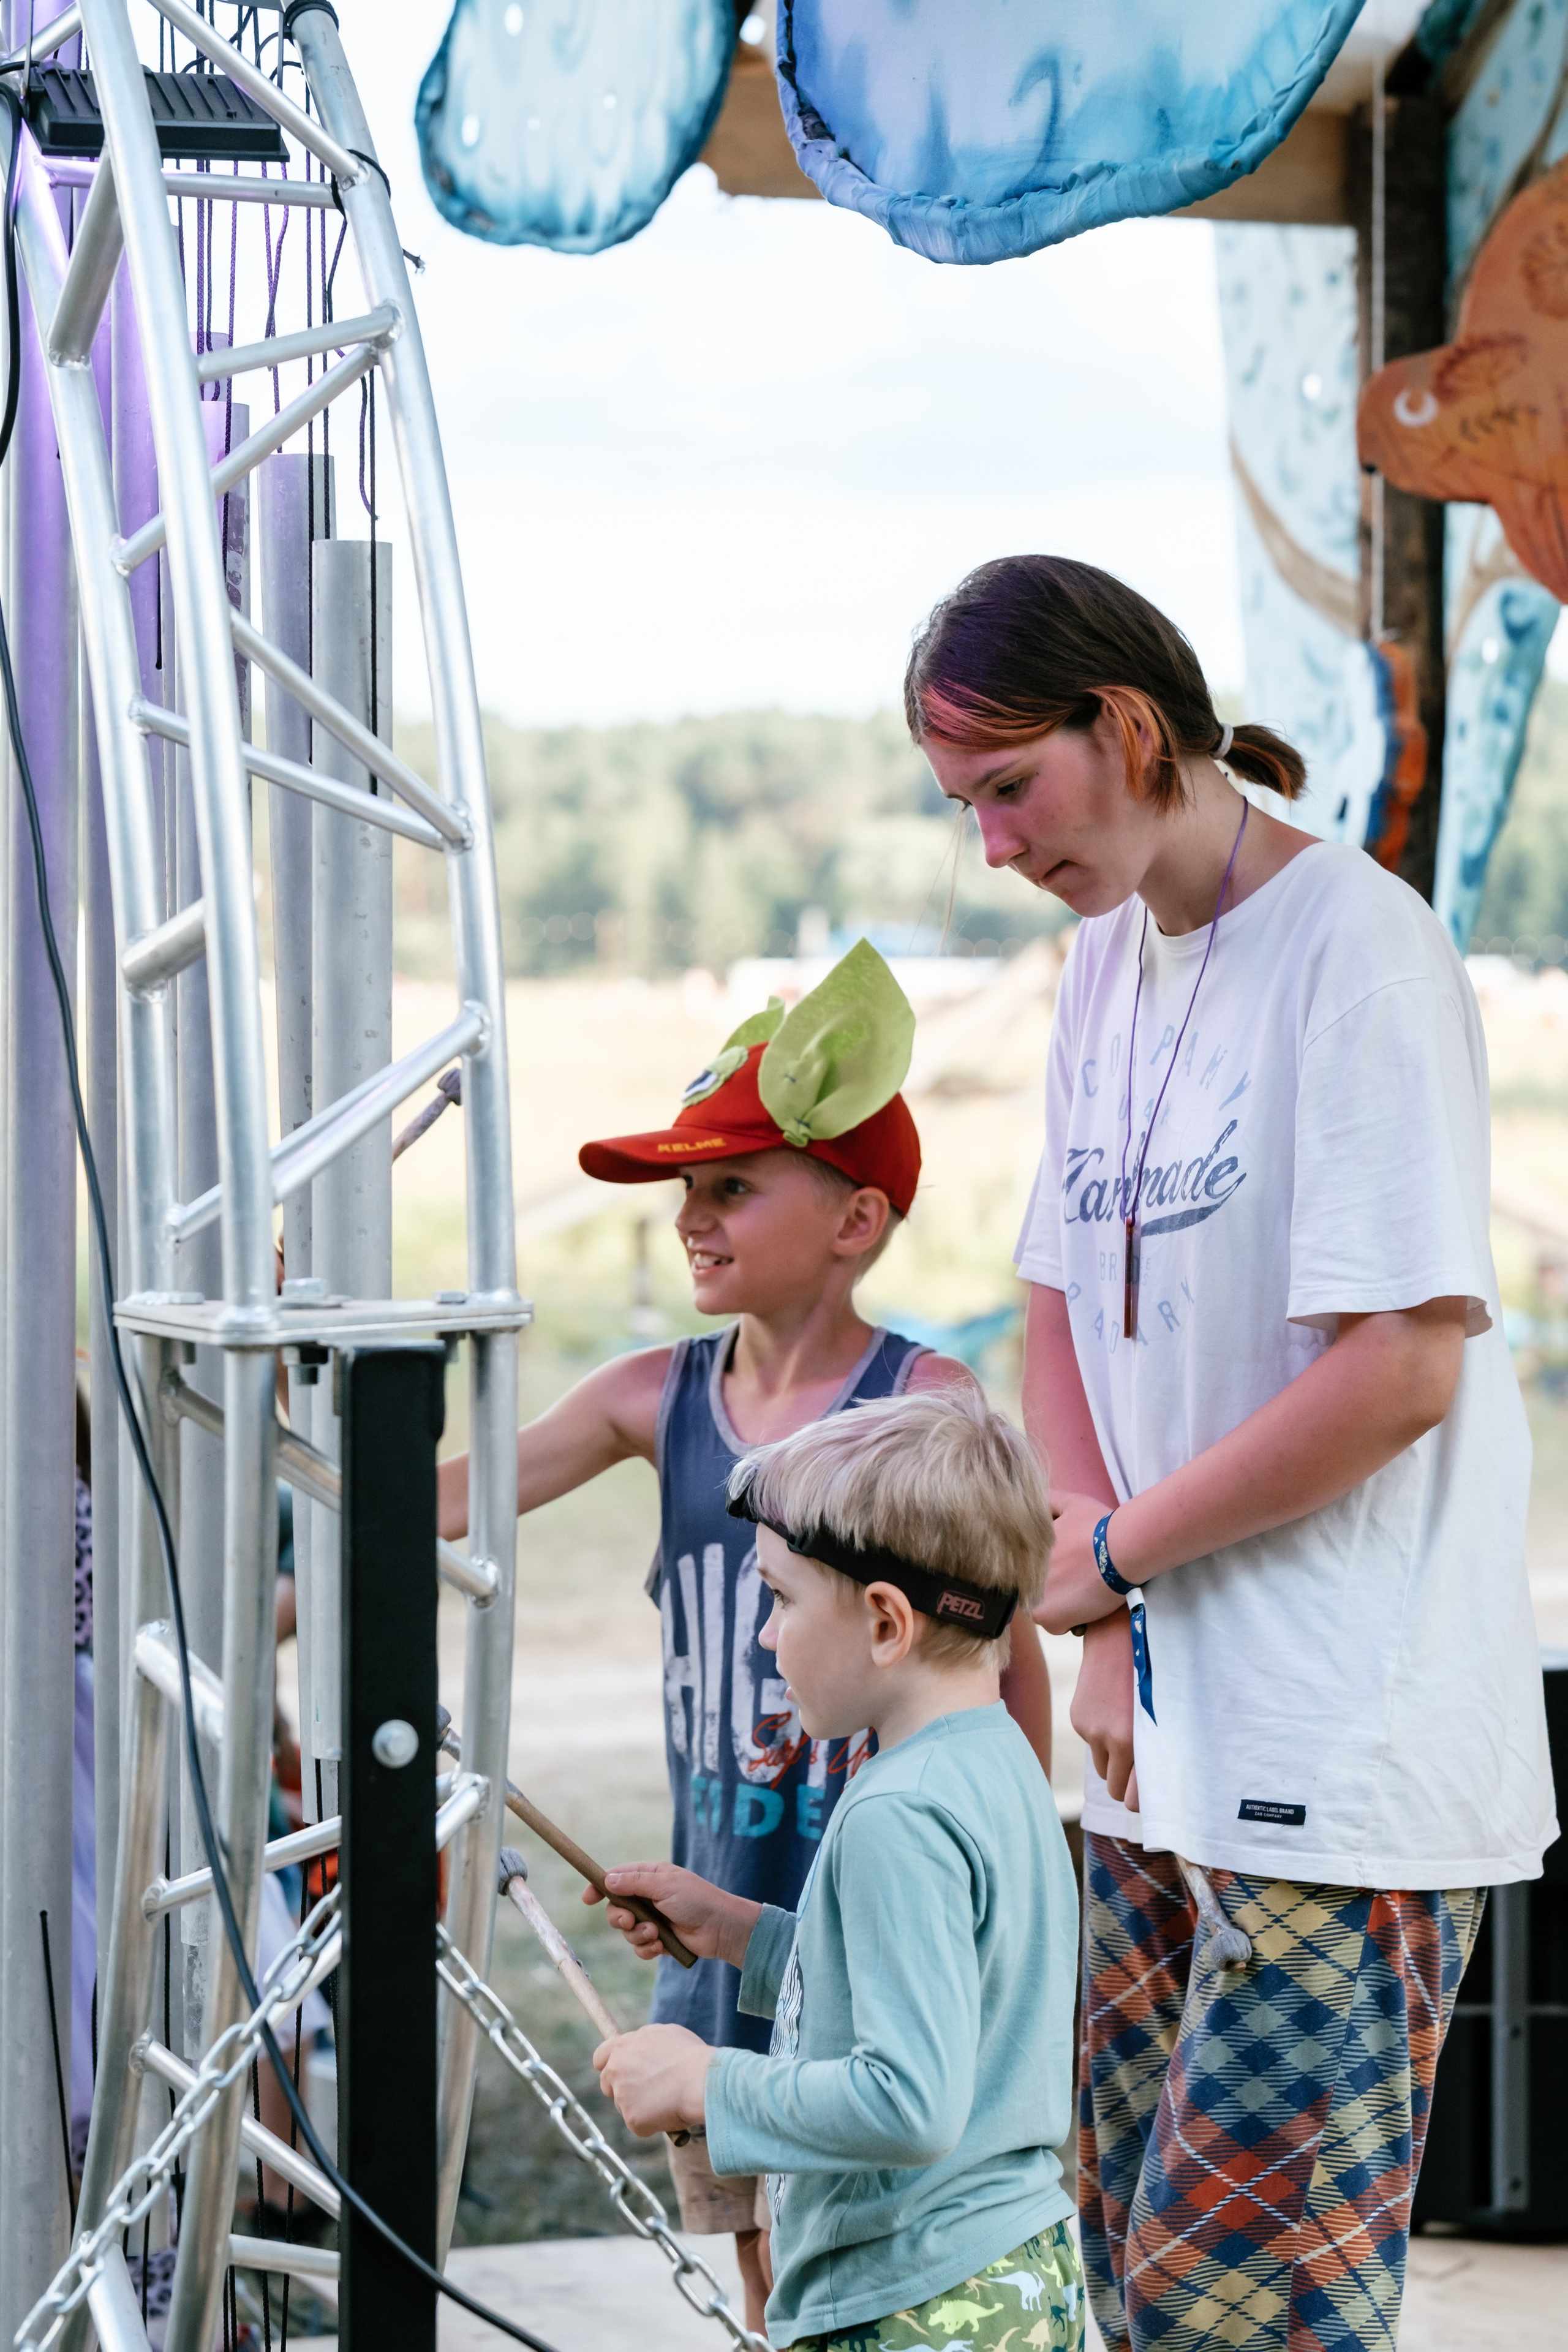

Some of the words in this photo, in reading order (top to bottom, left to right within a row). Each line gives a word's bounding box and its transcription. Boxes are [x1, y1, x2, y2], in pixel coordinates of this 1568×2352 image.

[1081, 1025, 1252, 1112] COPANY
[658, 1137, 726, 1153] KELME
[937, 1592, 984, 1620] PETZL
[660, 1542, 871, 1788] HIG
[691, 1775, 826, 1841] TIDE
